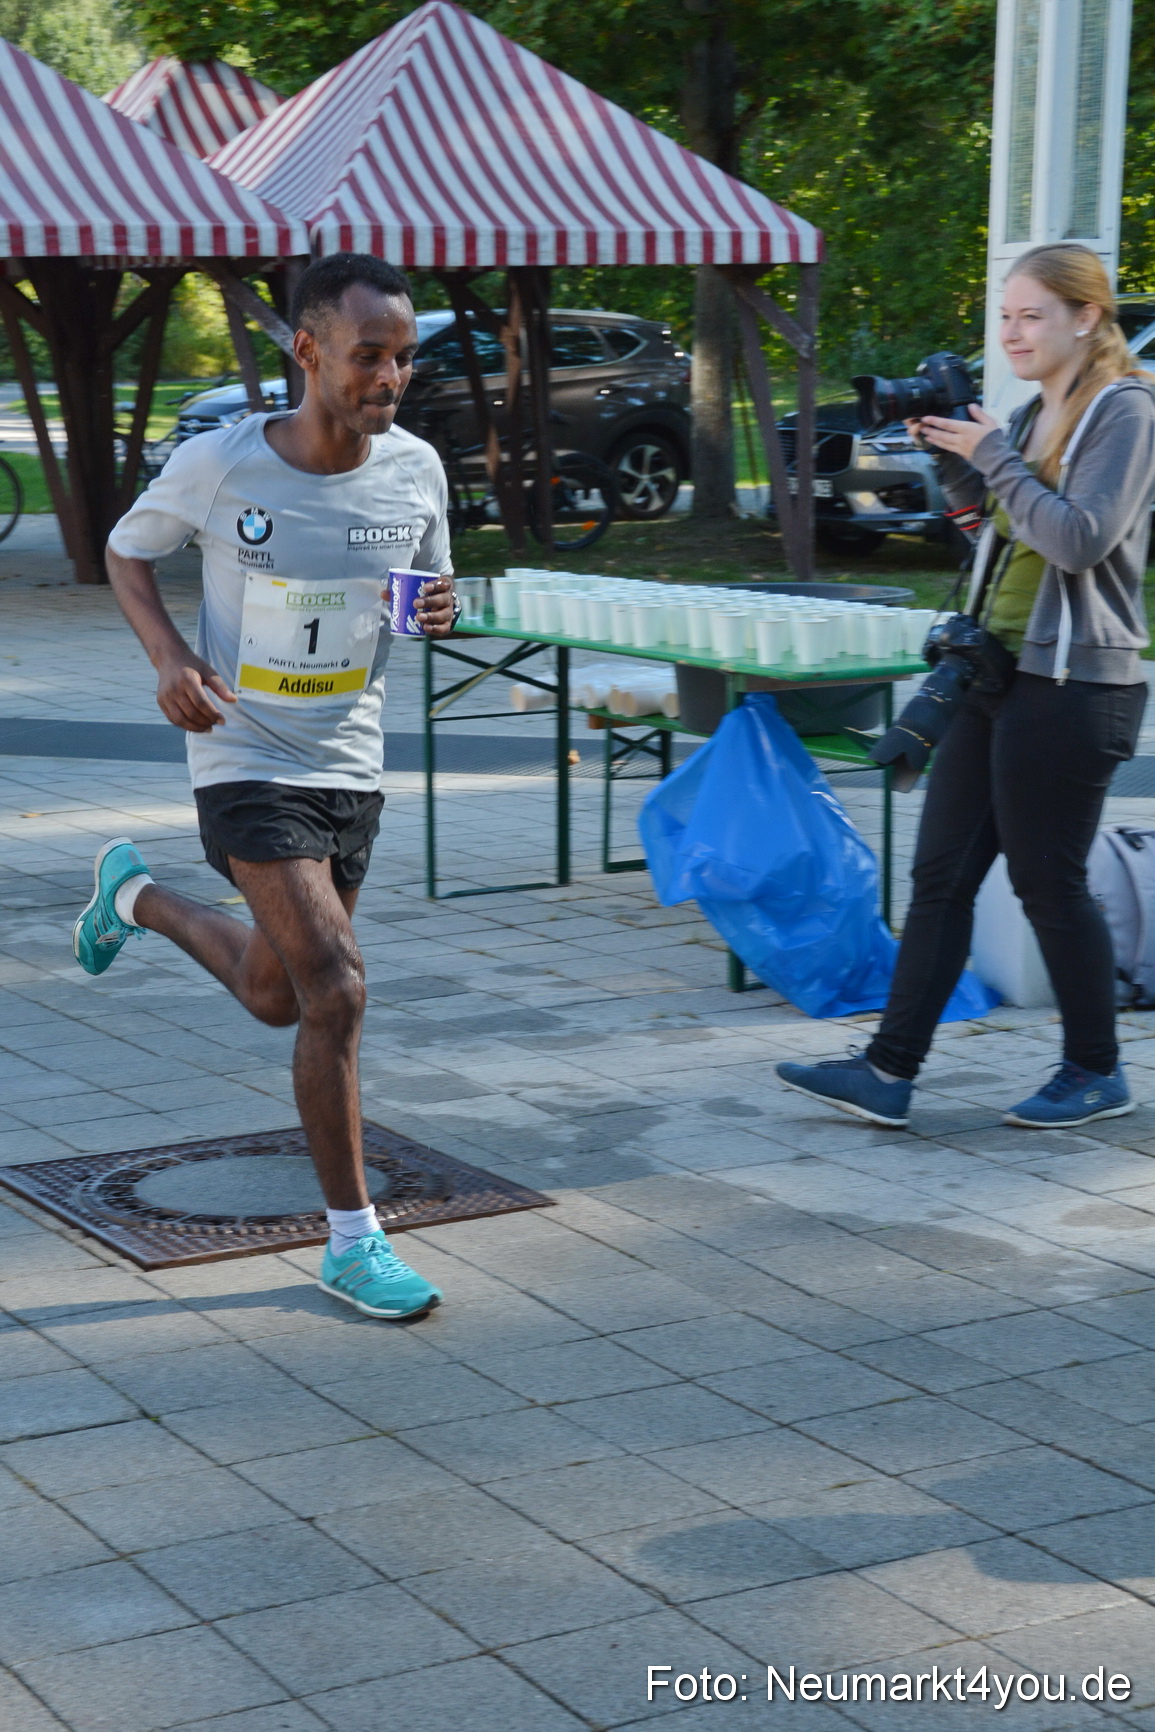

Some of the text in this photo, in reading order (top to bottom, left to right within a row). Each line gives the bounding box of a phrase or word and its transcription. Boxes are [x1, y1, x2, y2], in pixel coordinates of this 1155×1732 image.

[348, 526, 412, 543] BOCK
[237, 547, 275, 562] PARTL
[286, 591, 346, 606] BOCK
[303, 617, 320, 655] 1
[268, 656, 338, 669] PARTL Neumarkt
[278, 677, 334, 694] Addisu
